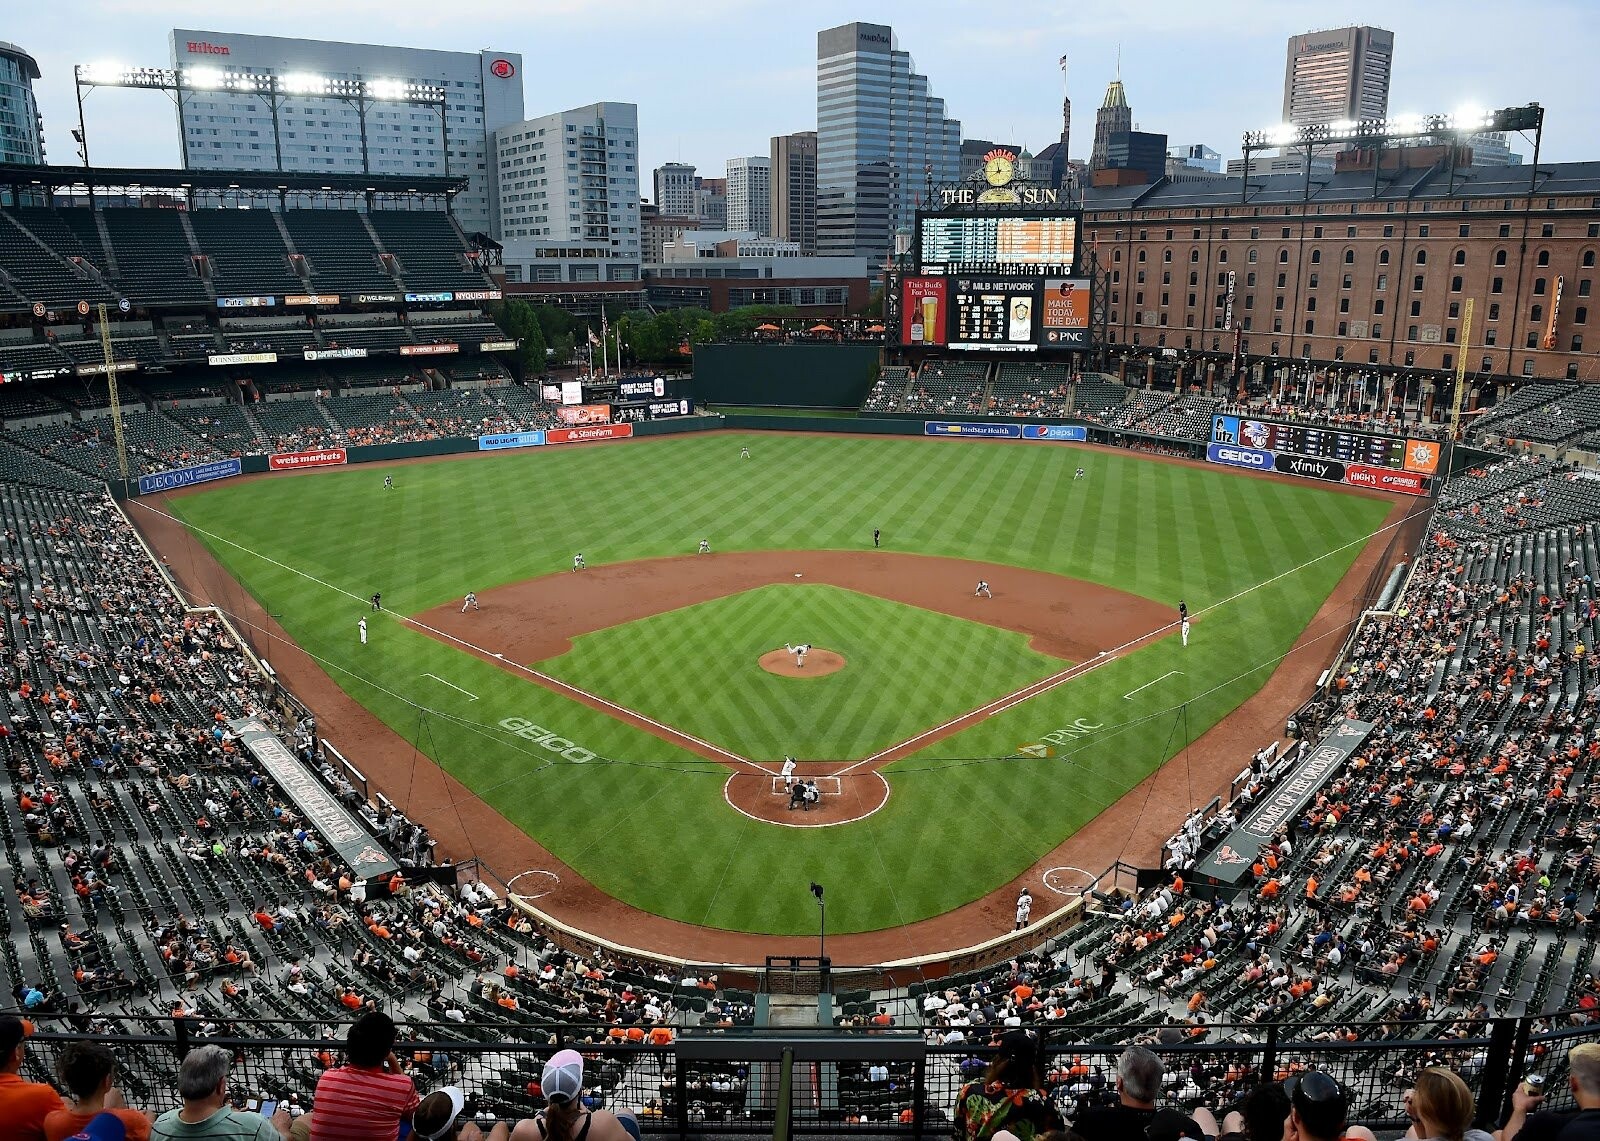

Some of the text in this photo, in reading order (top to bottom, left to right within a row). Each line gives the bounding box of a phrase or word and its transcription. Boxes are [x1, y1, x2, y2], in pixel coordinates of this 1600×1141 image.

[186, 41, 230, 55] Hilton
[983, 149, 1016, 162] ORIOLES
[940, 188, 1058, 204] THE SUN
[973, 282, 991, 290] MLB
[455, 292, 486, 300] NYQUIST
[911, 288, 923, 296] For
[81, 304, 86, 312] 8
[121, 301, 129, 309] 42
[1047, 300, 1073, 308] MAKE
[35, 305, 44, 314] 33
[1047, 308, 1075, 317] TODAY
[1047, 317, 1063, 326] THE
[1060, 332, 1083, 342] PNC
[342, 348, 366, 357] UNION
[243, 354, 268, 362] BLONDE
[962, 426, 987, 434] MedStar
[988, 427, 1009, 435] Health
[1050, 428, 1074, 437] pepsi
[519, 434, 539, 443] SELTZER
[275, 452, 341, 465] weis markets
[1218, 448, 1264, 465] GEICO
[1289, 459, 1329, 477] xfinity
[145, 470, 194, 490] LECOM
[1350, 471, 1377, 485] HIGH'S
[1039, 718, 1104, 745] PNC
[498, 717, 597, 763] GEICO
[256, 739, 357, 841] WELCOME TO ORIOLE PARK
[1249, 748, 1340, 833] HOME OF THE ORIOLES
